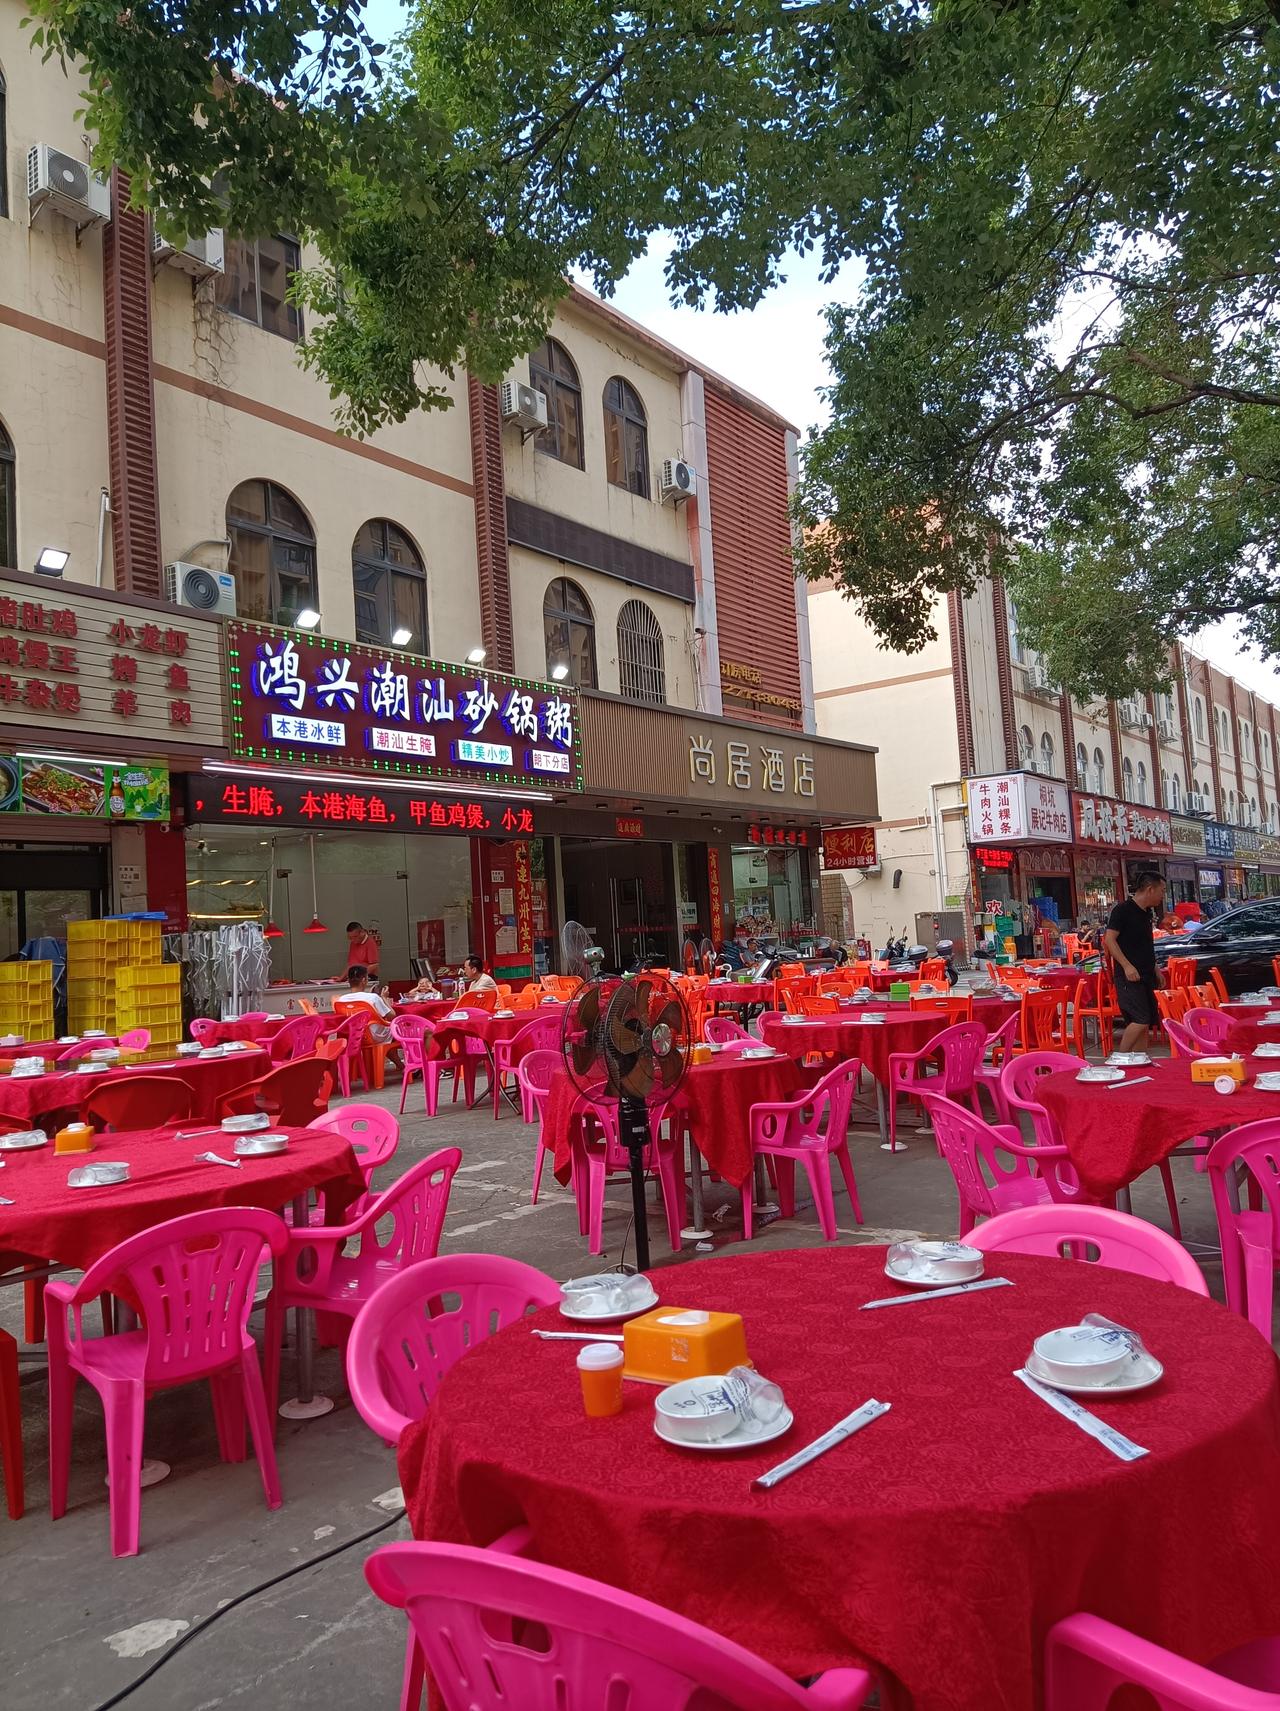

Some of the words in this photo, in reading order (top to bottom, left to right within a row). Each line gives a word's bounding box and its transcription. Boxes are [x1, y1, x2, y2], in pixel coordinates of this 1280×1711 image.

[110, 618, 189, 656] 小龙虾
[258, 640, 573, 748] 鸿兴潮汕砂锅粥
[276, 718, 343, 743] 本港冰鲜
[376, 731, 433, 754] 潮汕生腌
[461, 742, 510, 762] 精美小炒
[689, 736, 815, 798] 尚居酒店
[979, 783, 994, 836] 牛肉火锅
[997, 781, 1012, 835] 潮汕粿条
[824, 832, 875, 855] 便利店
[827, 855, 875, 867] 24小时营业
